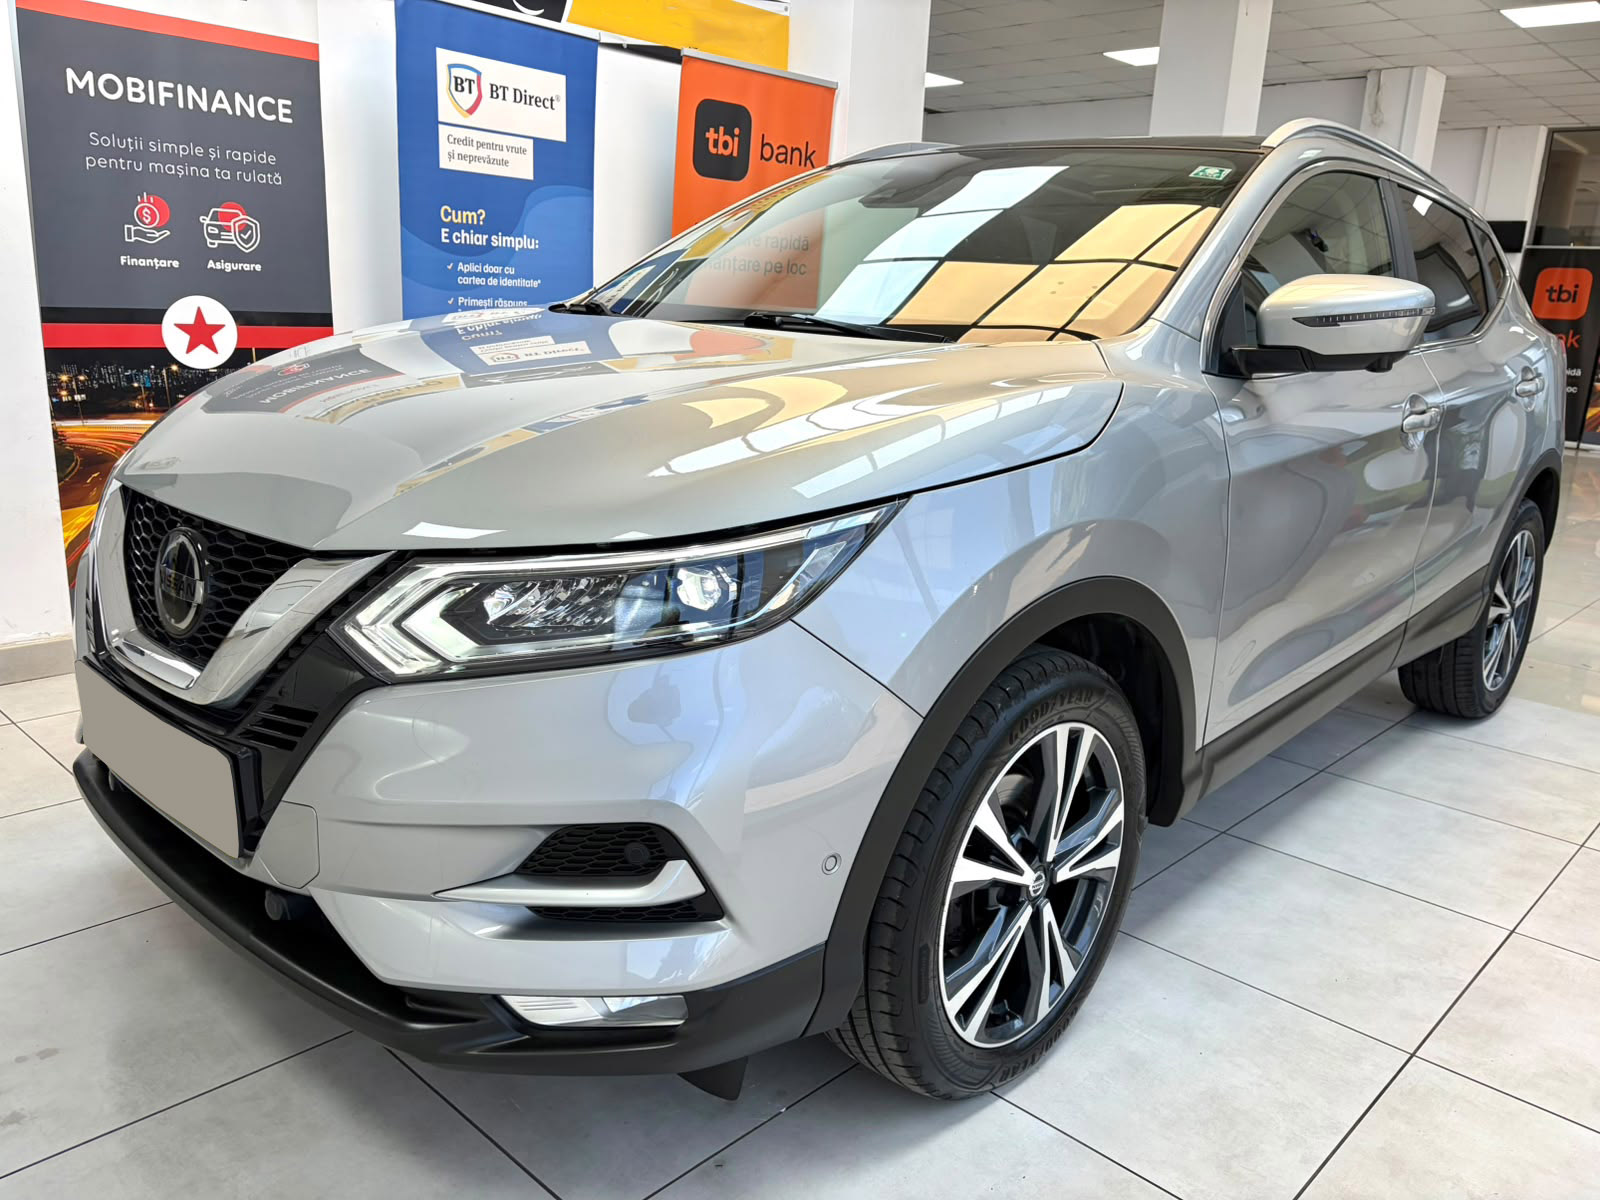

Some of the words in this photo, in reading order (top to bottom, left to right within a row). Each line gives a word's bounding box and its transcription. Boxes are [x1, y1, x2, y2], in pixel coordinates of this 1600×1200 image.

[65, 67, 294, 124] MOBIFINANCE
[453, 75, 476, 95] BT
[489, 83, 509, 102] BT
[89, 131, 144, 152] Soluții
[148, 138, 204, 158] simple
[208, 146, 221, 162] și
[226, 150, 277, 167] rapide
[446, 133, 475, 149] Credit
[476, 139, 505, 154] pentru
[505, 142, 528, 156] vrute
[705, 126, 741, 158] tbi
[759, 133, 817, 169] bank
[447, 149, 455, 163] și
[457, 151, 510, 168] neprevăzute
[85, 154, 144, 173] pentru
[149, 160, 210, 178] mașina
[215, 166, 231, 181] ta
[236, 169, 283, 186] rulată
[440, 205, 486, 226] Cum?
[440, 228, 450, 244] E
[452, 230, 488, 247] chiar
[490, 233, 540, 252] simplu:
[120, 255, 181, 271] Finanțare
[207, 258, 263, 273] Asigurare
[457, 262, 482, 273] Aplici
[483, 263, 502, 274] doar
[504, 266, 515, 275] cu
[764, 259, 784, 277] pe
[786, 257, 807, 276] loc
[457, 275, 486, 286] cartea
[487, 276, 498, 287] de
[1545, 283, 1580, 304] tbi
